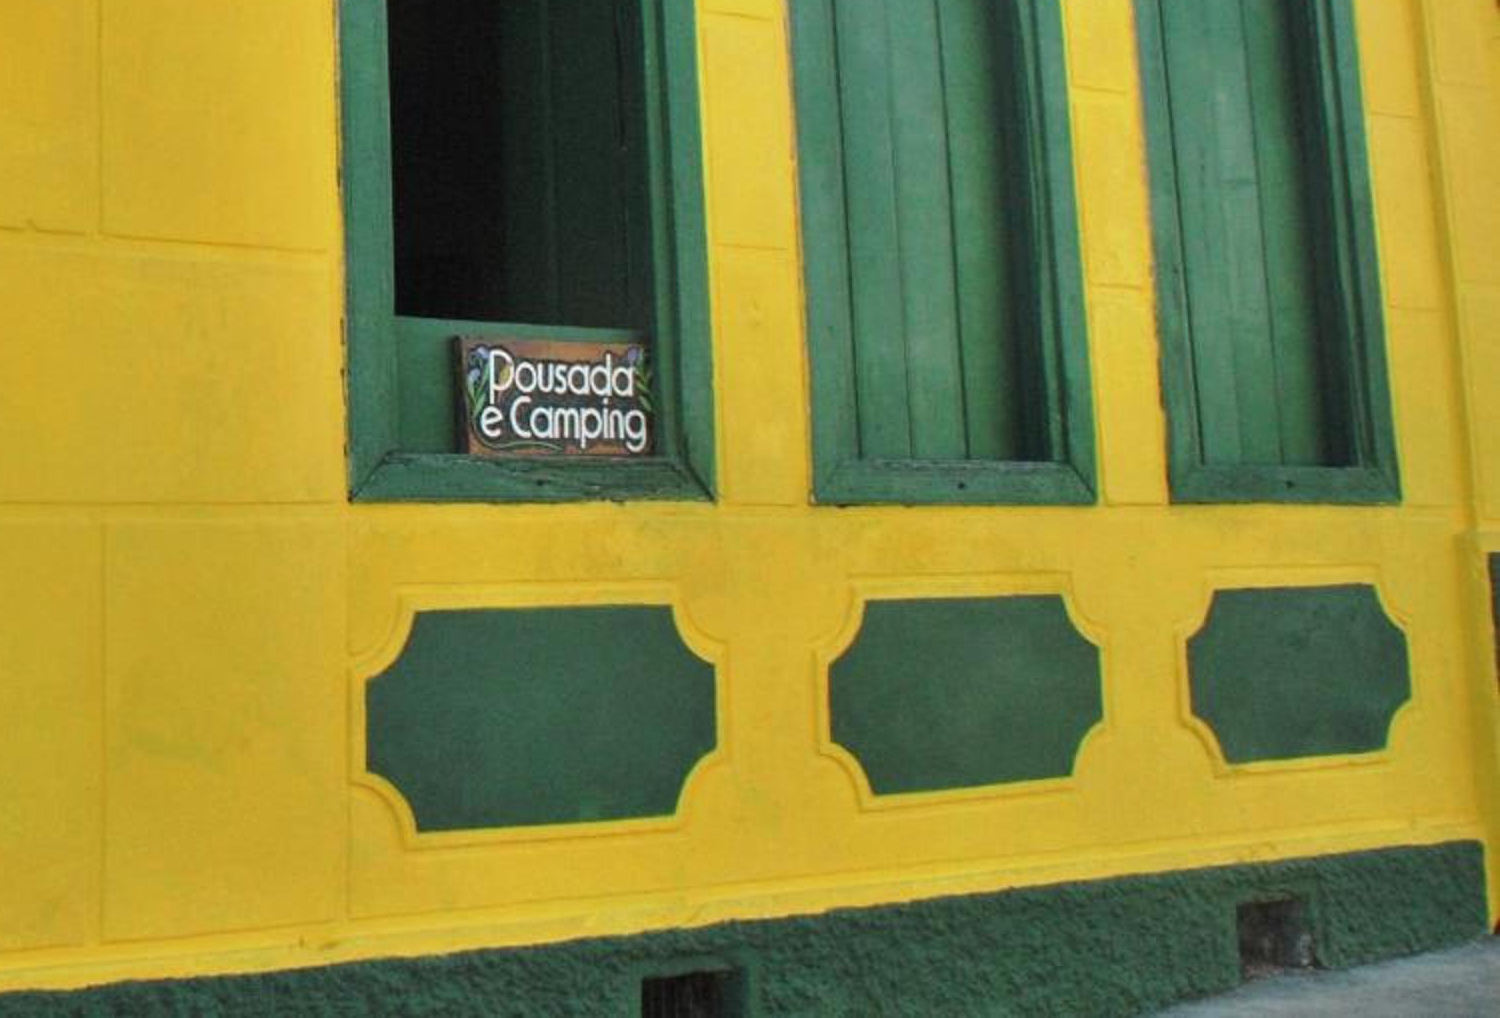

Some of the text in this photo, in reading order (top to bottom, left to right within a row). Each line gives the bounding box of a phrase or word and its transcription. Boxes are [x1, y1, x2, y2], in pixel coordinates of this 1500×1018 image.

[488, 348, 635, 405] Pousada
[480, 395, 648, 453] e Camping
